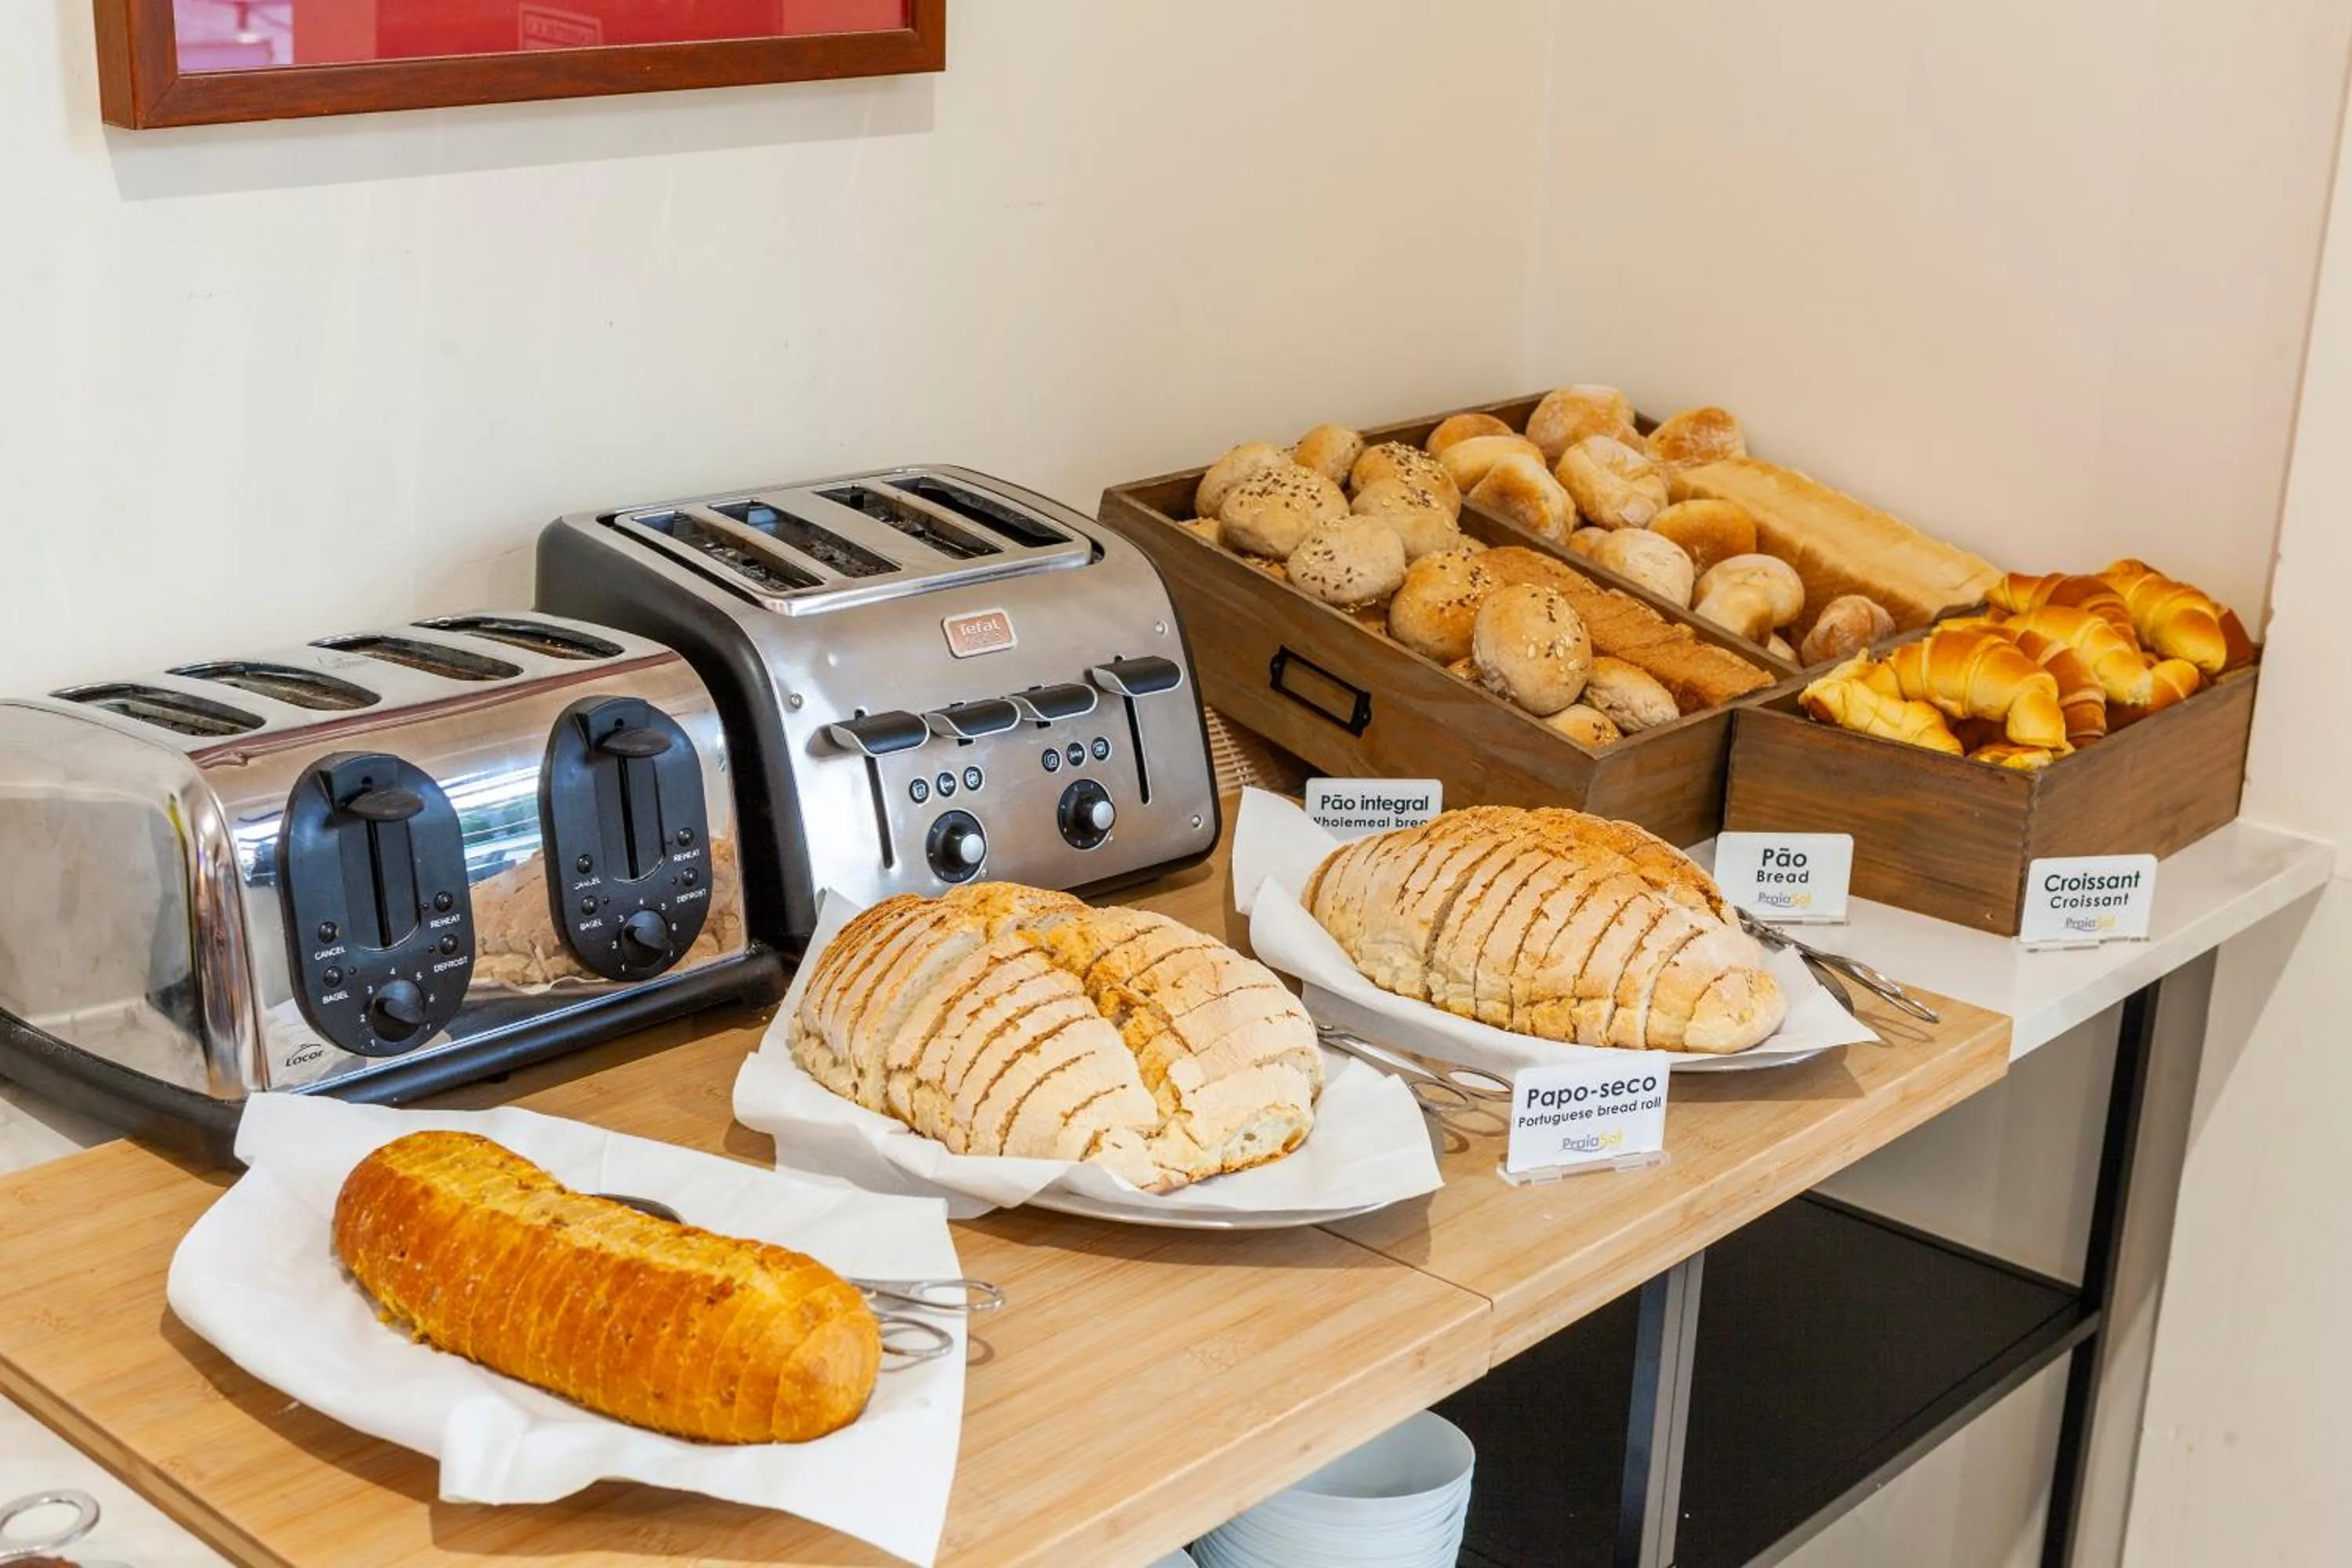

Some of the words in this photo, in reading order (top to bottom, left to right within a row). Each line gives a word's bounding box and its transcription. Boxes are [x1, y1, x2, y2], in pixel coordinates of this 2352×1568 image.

[959, 618, 1001, 636] Tefal
[1320, 794, 1356, 811] Pão
[1360, 794, 1429, 815] integral
[1396, 816, 1428, 829] bre
[1762, 848, 1808, 867] Pão
[1756, 869, 1809, 884] Bread
[2044, 869, 2142, 893] Croissant
[2050, 892, 2129, 909] Croissant
[430, 913, 461, 929] REHEAT
[314, 946, 346, 960] CANCEL
[434, 956, 468, 973] DEFROST
[322, 993, 349, 1004] BAGEL
[1526, 1076, 1657, 1109] Papo-seco
[1518, 1109, 1593, 1128] Portuguese
[1597, 1100, 1638, 1117] bread
[1641, 1096, 1661, 1110] roll
